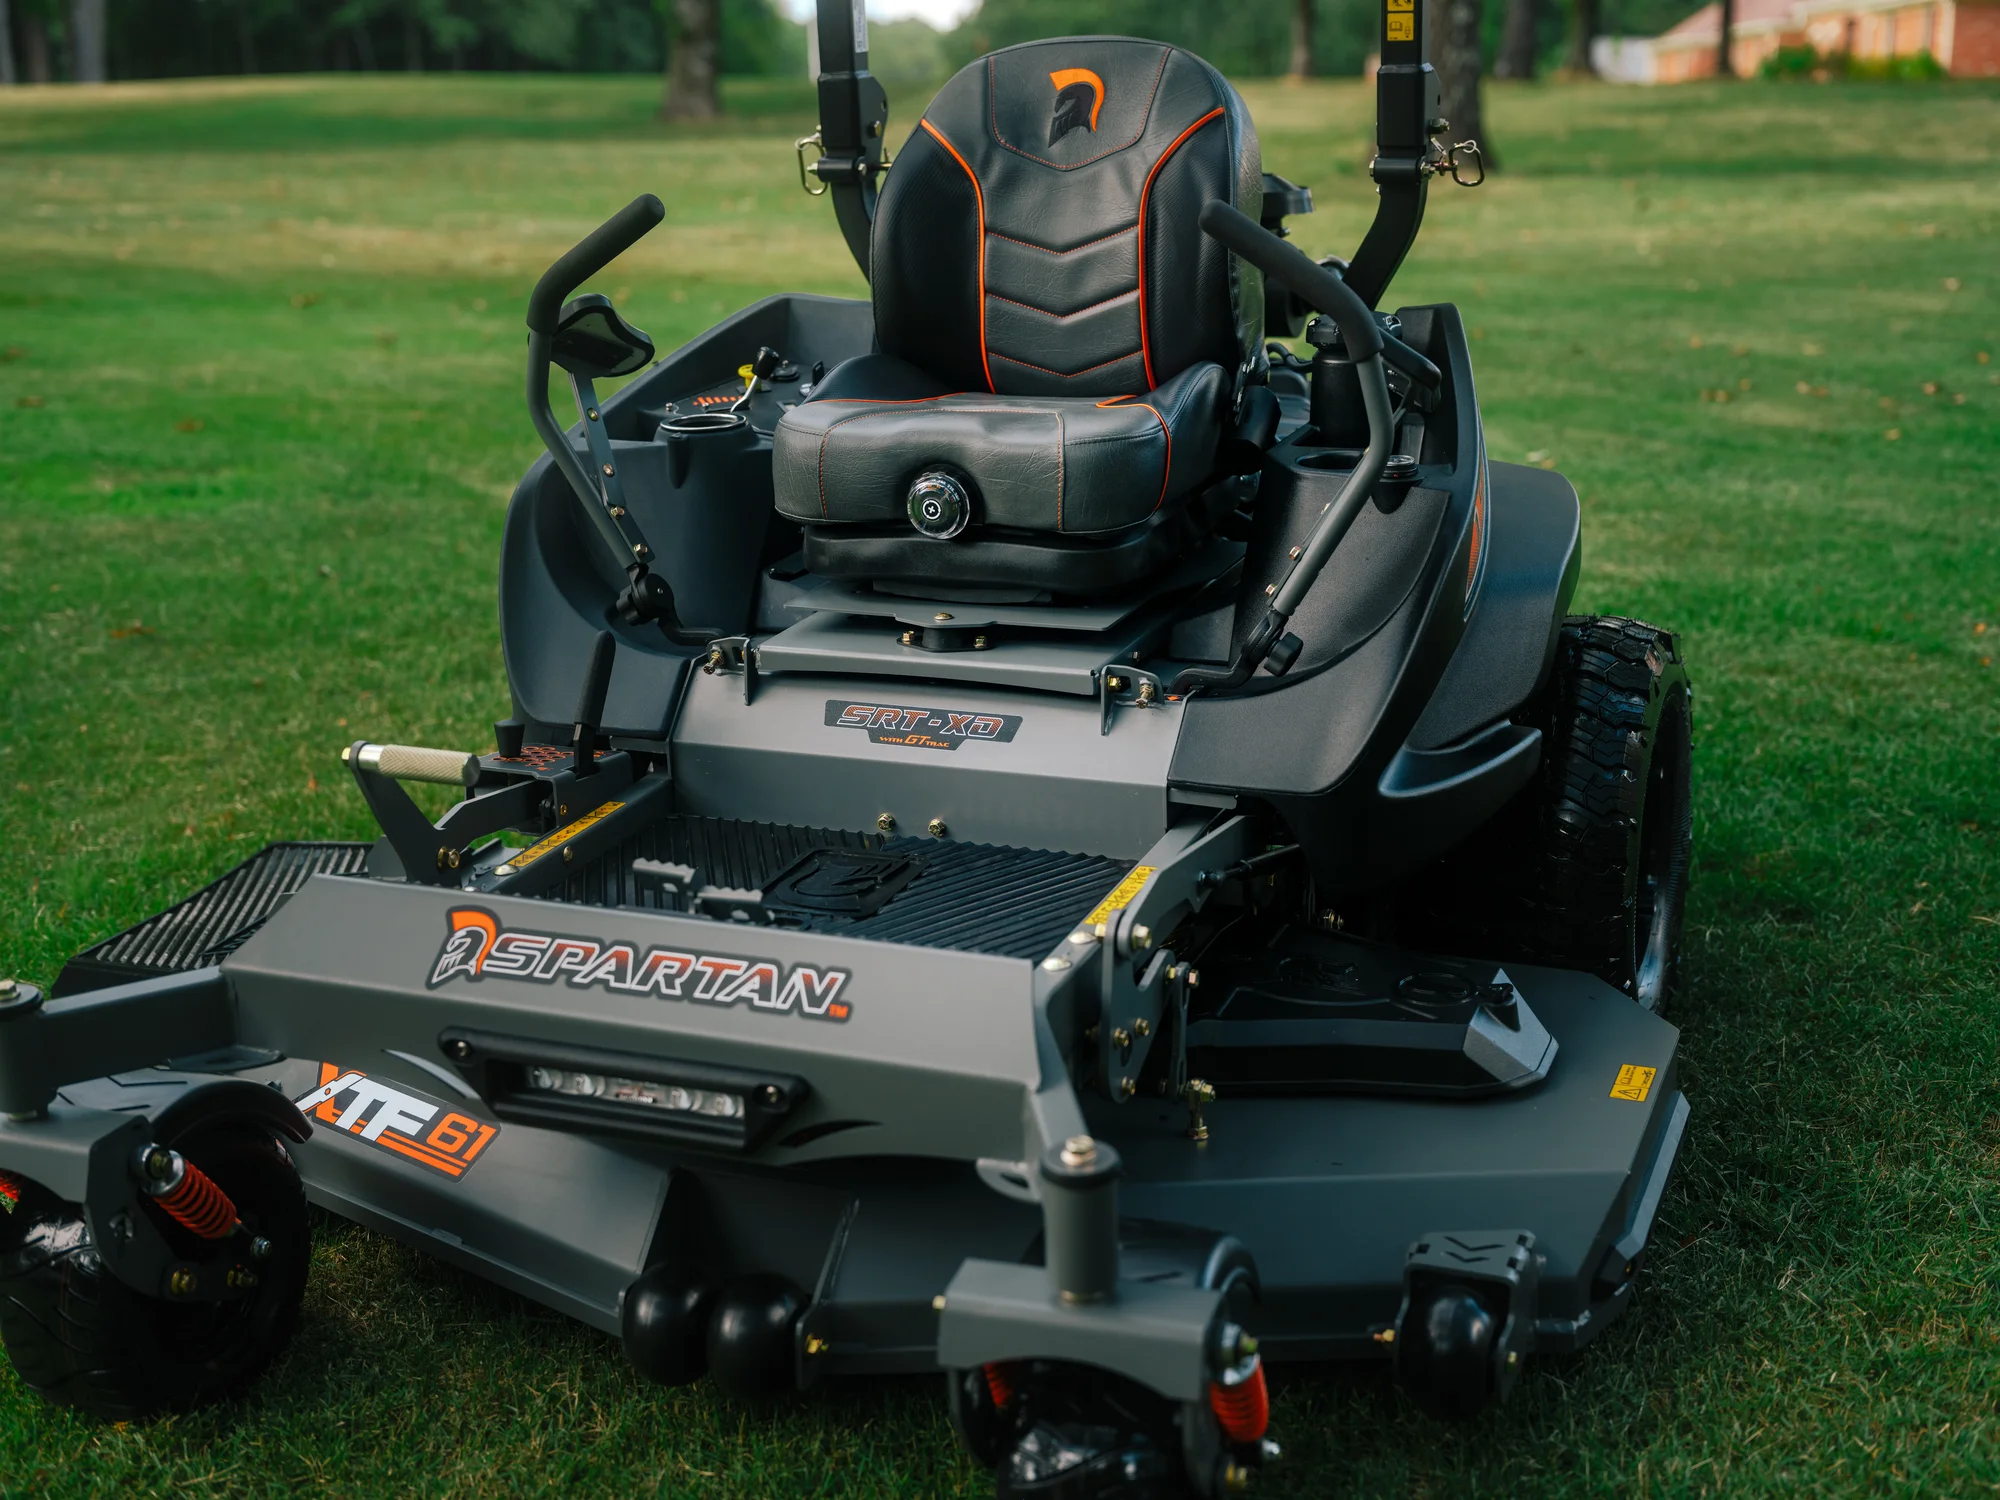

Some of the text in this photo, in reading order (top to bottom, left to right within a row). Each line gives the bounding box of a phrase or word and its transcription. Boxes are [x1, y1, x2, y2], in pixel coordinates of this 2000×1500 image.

[480, 933, 846, 1015] SPARTAN
[294, 1061, 497, 1161] XTF 61
